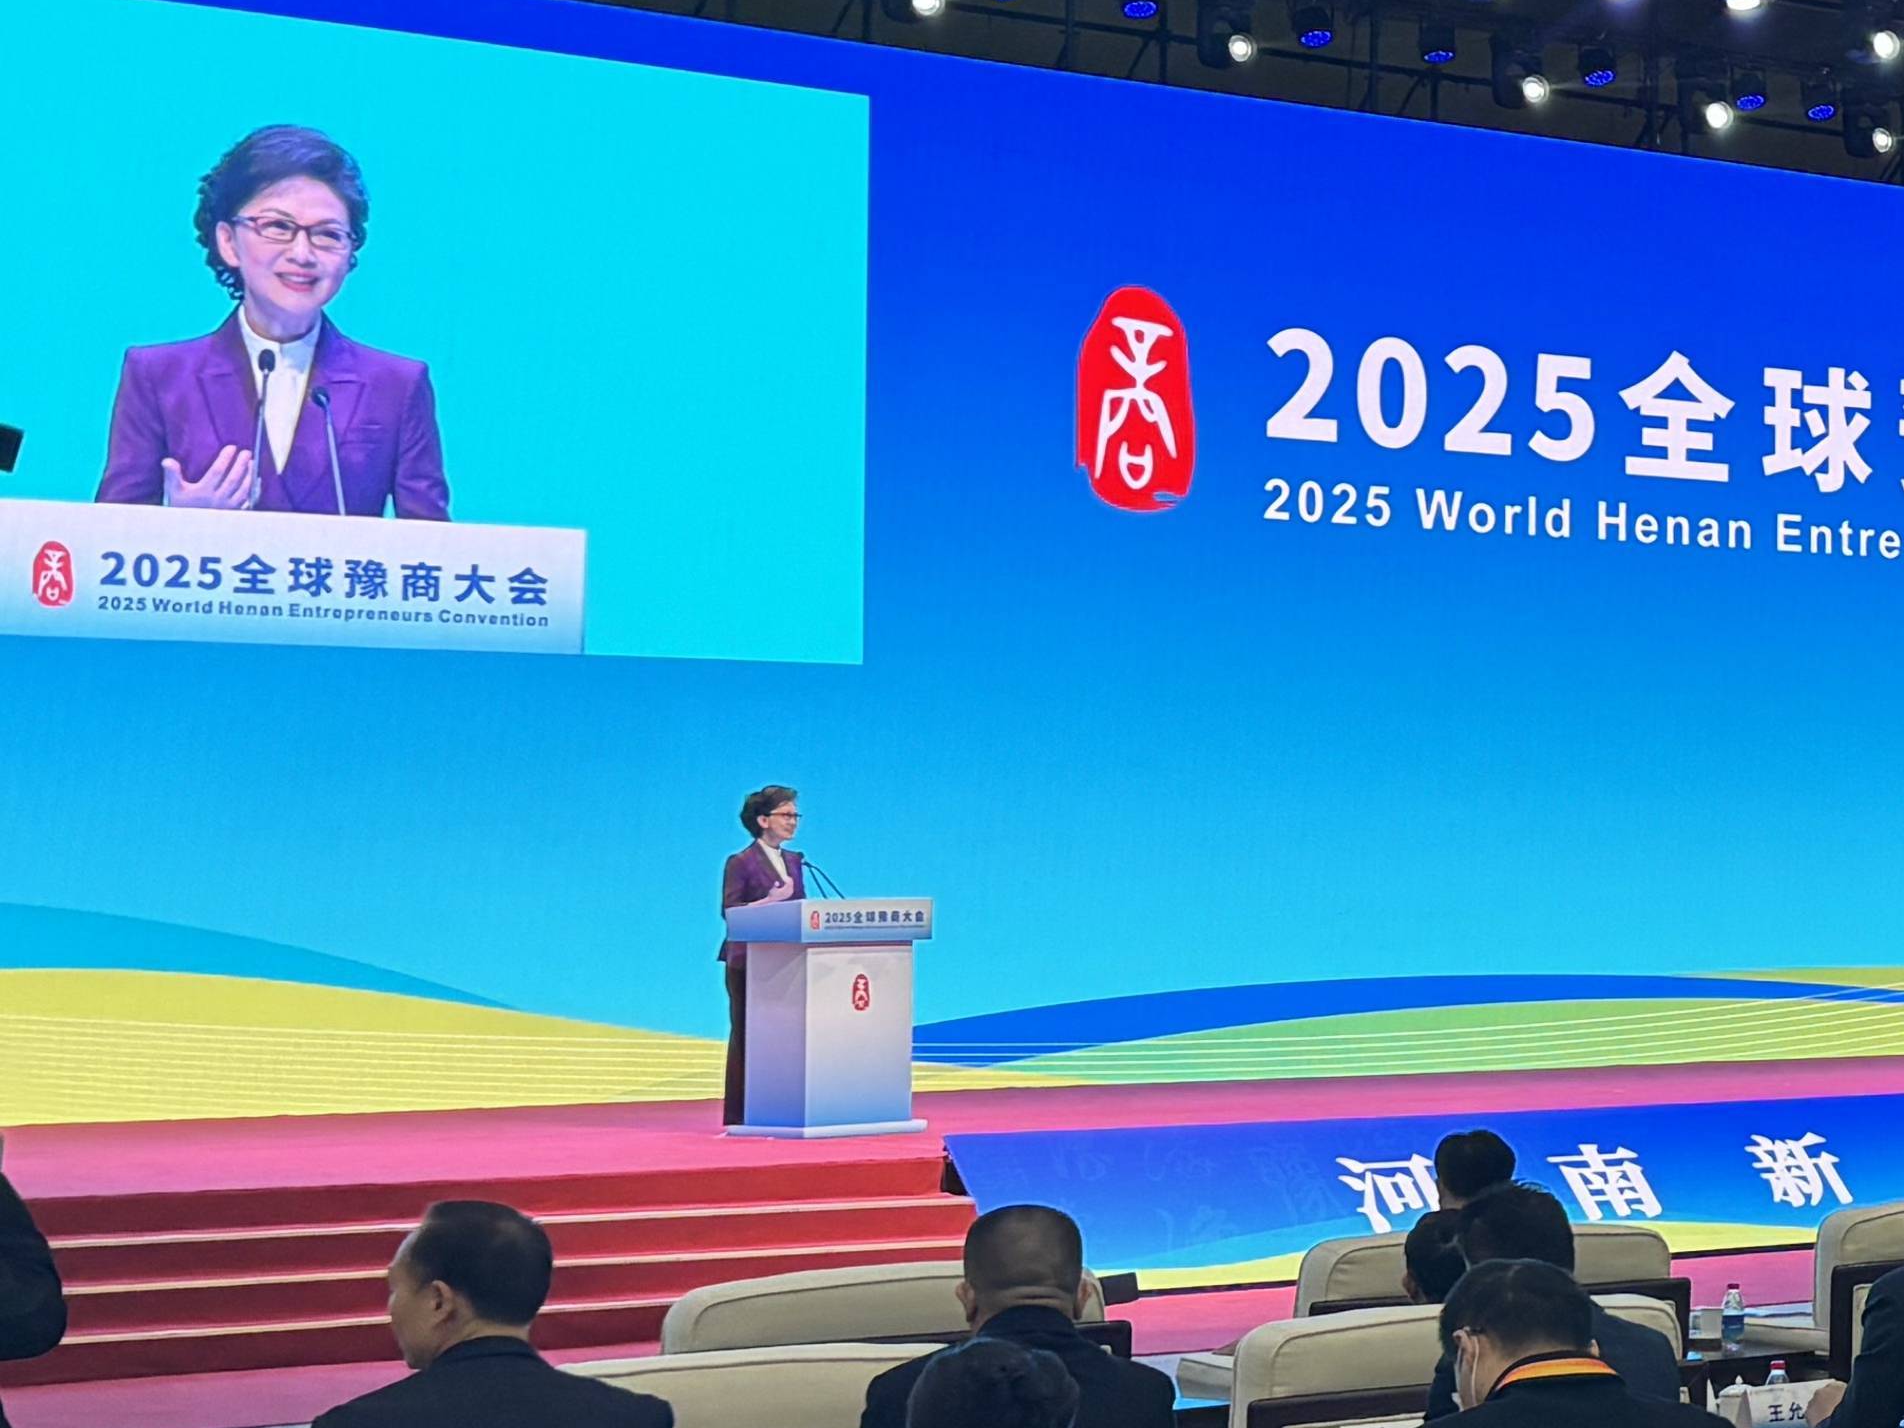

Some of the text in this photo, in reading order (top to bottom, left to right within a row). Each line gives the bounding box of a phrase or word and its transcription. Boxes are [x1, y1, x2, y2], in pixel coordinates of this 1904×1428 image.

[1263, 477, 1392, 527] 2025
[1415, 488, 1572, 538] World
[1597, 501, 1752, 549] Henan
[98, 551, 550, 607] 2025全球豫商大会
[98, 595, 549, 629] 2025 World Henan Entrepreneurs Convention
[824, 910, 925, 925] 2025全球豫商大会
